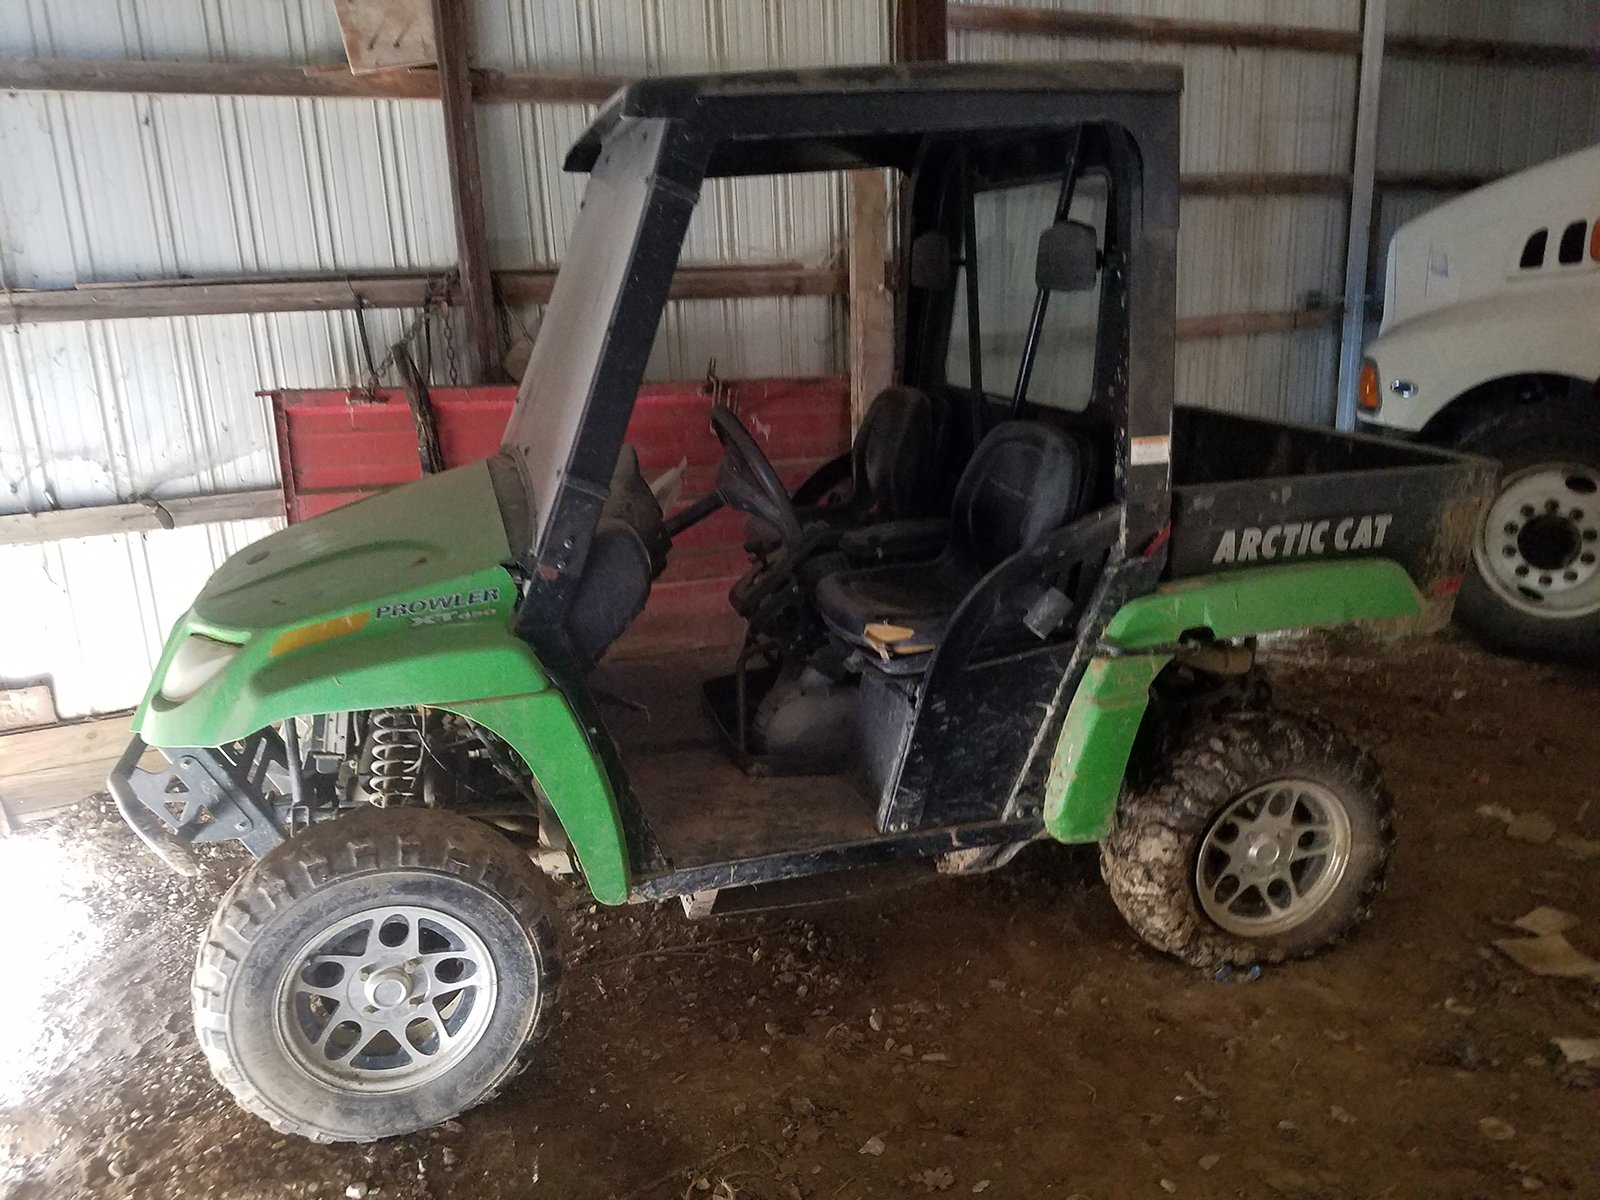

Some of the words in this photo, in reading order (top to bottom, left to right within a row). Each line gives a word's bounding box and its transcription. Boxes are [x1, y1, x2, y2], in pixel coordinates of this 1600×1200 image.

[1212, 519, 1330, 564] ARCTIC
[1334, 513, 1393, 551] CAT
[375, 587, 500, 621] PROWLER
